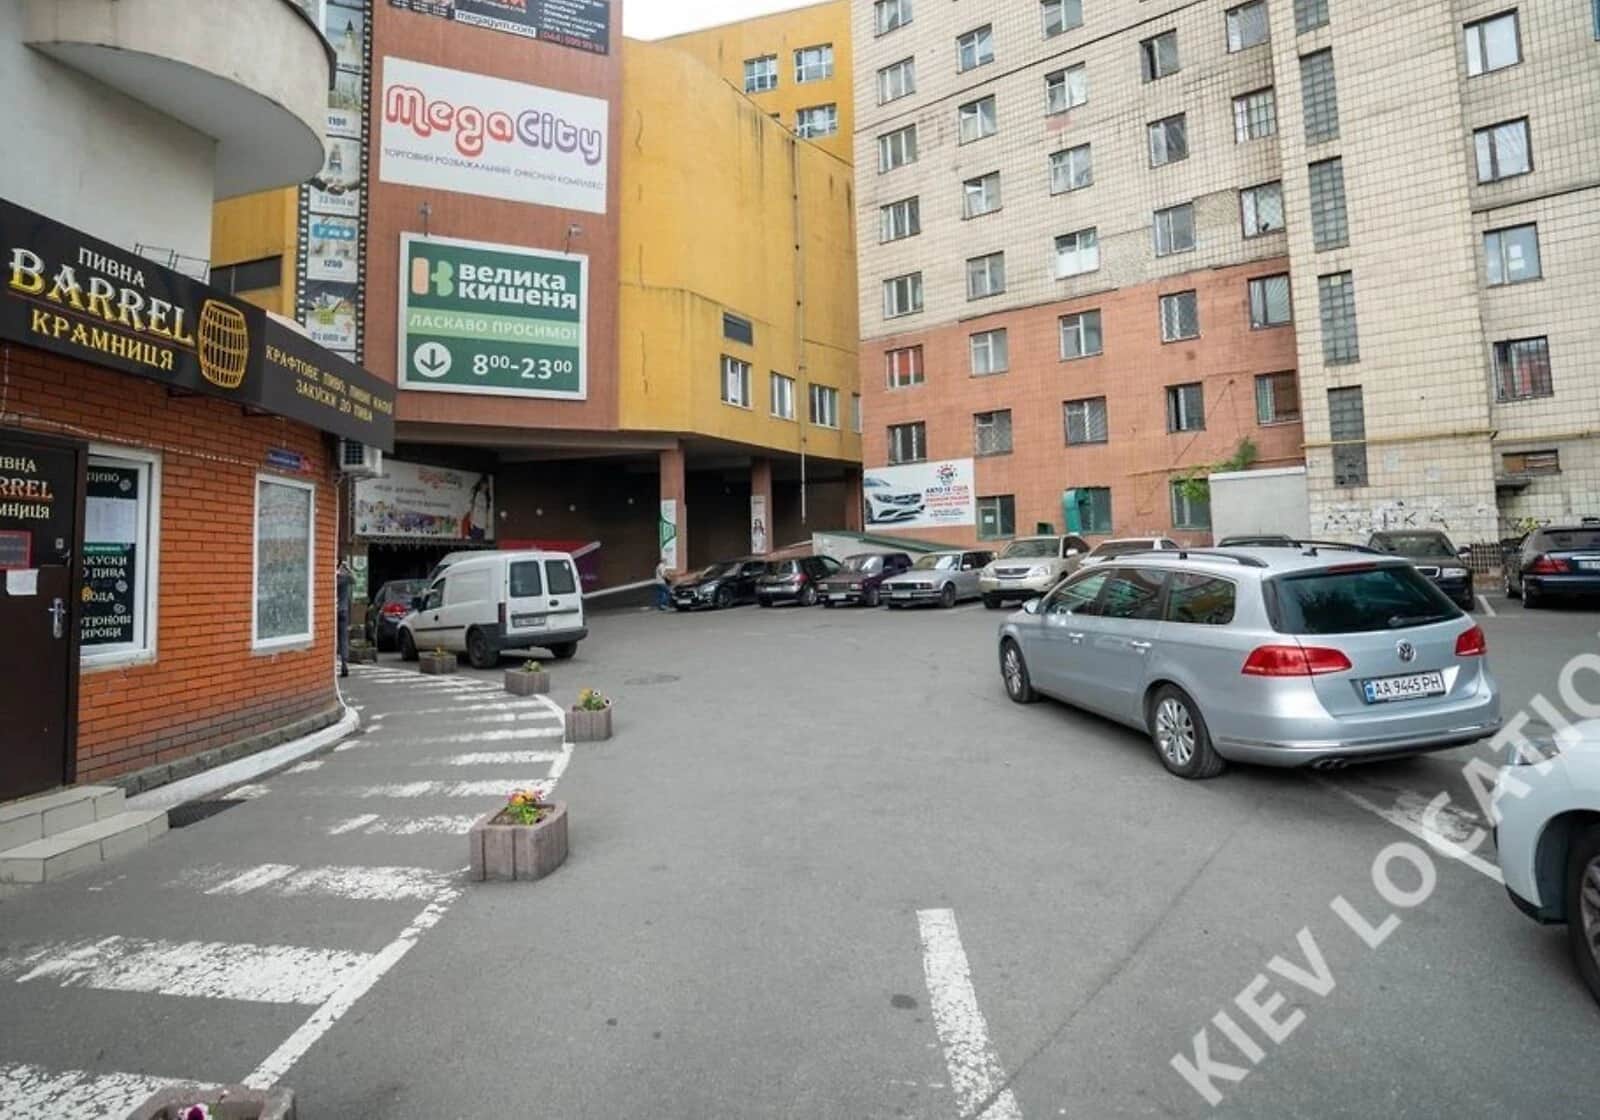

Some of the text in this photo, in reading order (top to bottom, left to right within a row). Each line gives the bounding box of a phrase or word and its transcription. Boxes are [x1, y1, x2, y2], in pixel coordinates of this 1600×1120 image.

[386, 84, 602, 166] MegaCity
[78, 246, 145, 289] ПИВНА
[458, 263, 566, 292] велика
[7, 246, 196, 347] BARREL
[458, 282, 577, 310] кишеня
[31, 308, 174, 371] КРАМНИЦЯ
[409, 313, 577, 341] ЛАСКАВО ПРОСИМО!
[265, 344, 319, 381] КРАФТОВЕ
[83, 555, 127, 568] КУСКИ
[81, 614, 131, 627] ТЮНОВІ
[1375, 676, 1440, 696] AA 9445 PH
